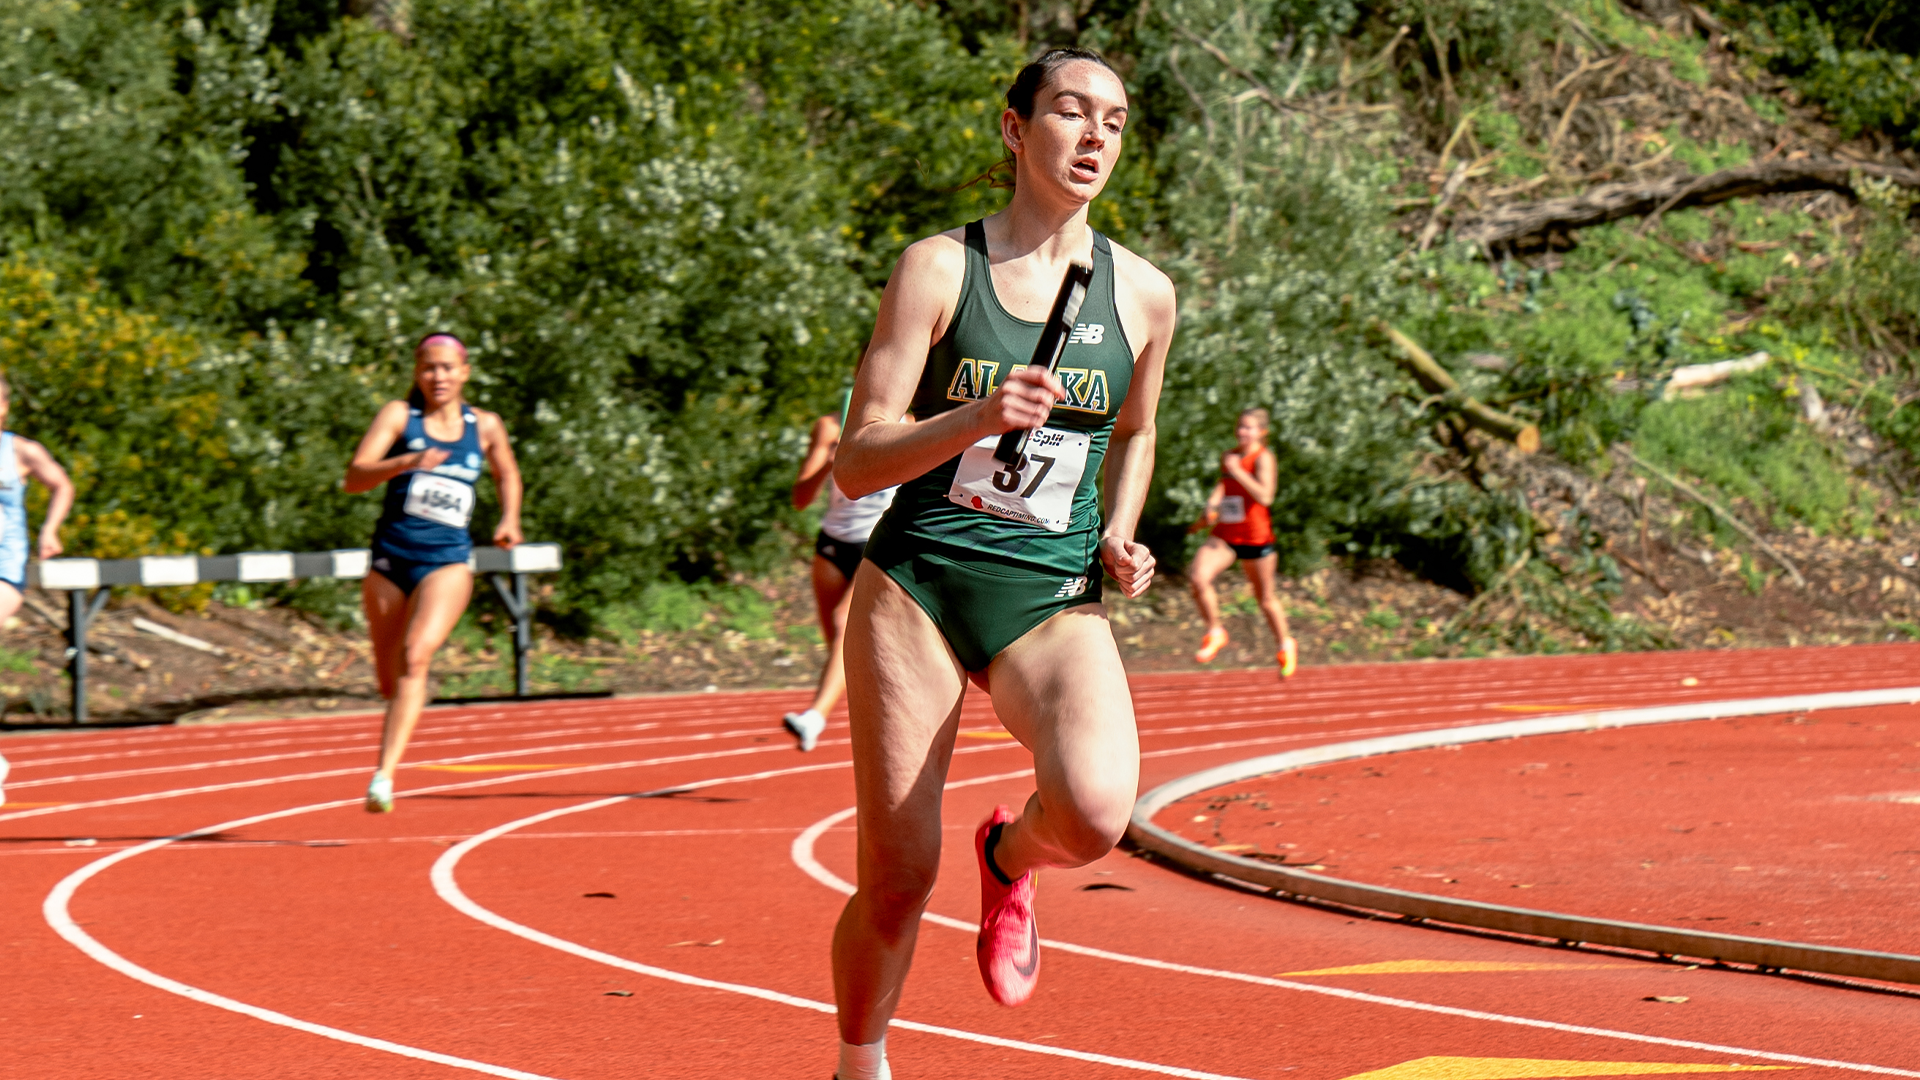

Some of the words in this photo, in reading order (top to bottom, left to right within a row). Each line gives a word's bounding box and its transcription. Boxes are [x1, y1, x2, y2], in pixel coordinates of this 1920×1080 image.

[947, 358, 1110, 415] ALKA
[1028, 430, 1064, 447] Split
[992, 453, 1056, 499] 37
